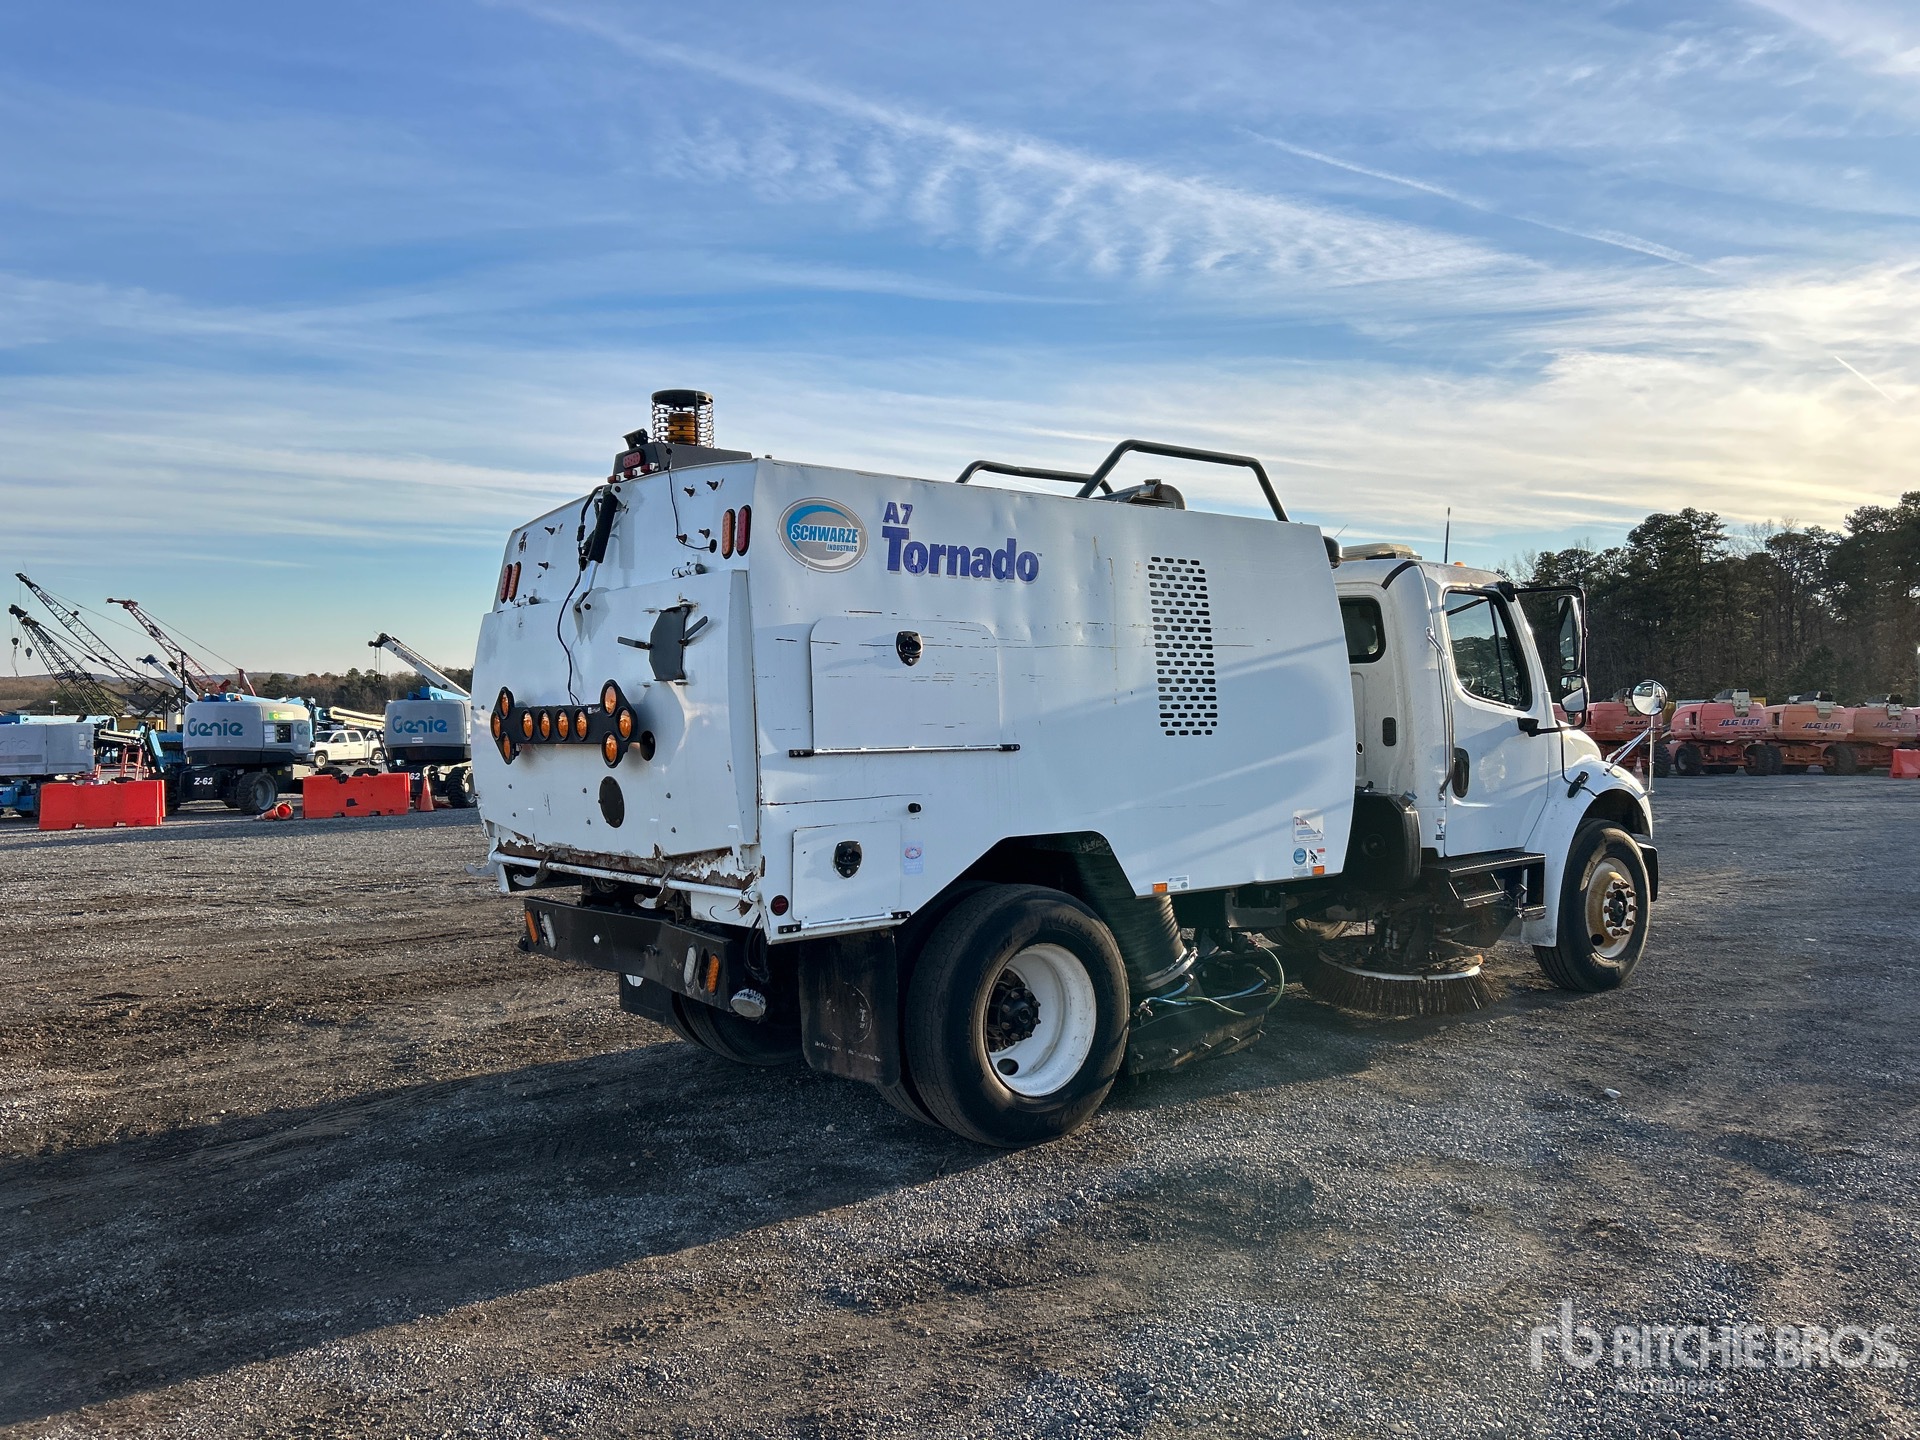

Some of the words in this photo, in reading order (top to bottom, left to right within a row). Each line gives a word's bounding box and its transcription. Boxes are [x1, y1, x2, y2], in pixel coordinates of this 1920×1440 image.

[883, 501, 913, 525] A7
[790, 524, 859, 544] SCHWARZE
[827, 543, 858, 553] INDUSTRIES
[881, 525, 1039, 583] Tornado
[188, 718, 243, 736] Genie
[392, 715, 447, 734] Genie
[1824, 722, 1841, 730] LIFT
[194, 777, 213, 786] Z-62
